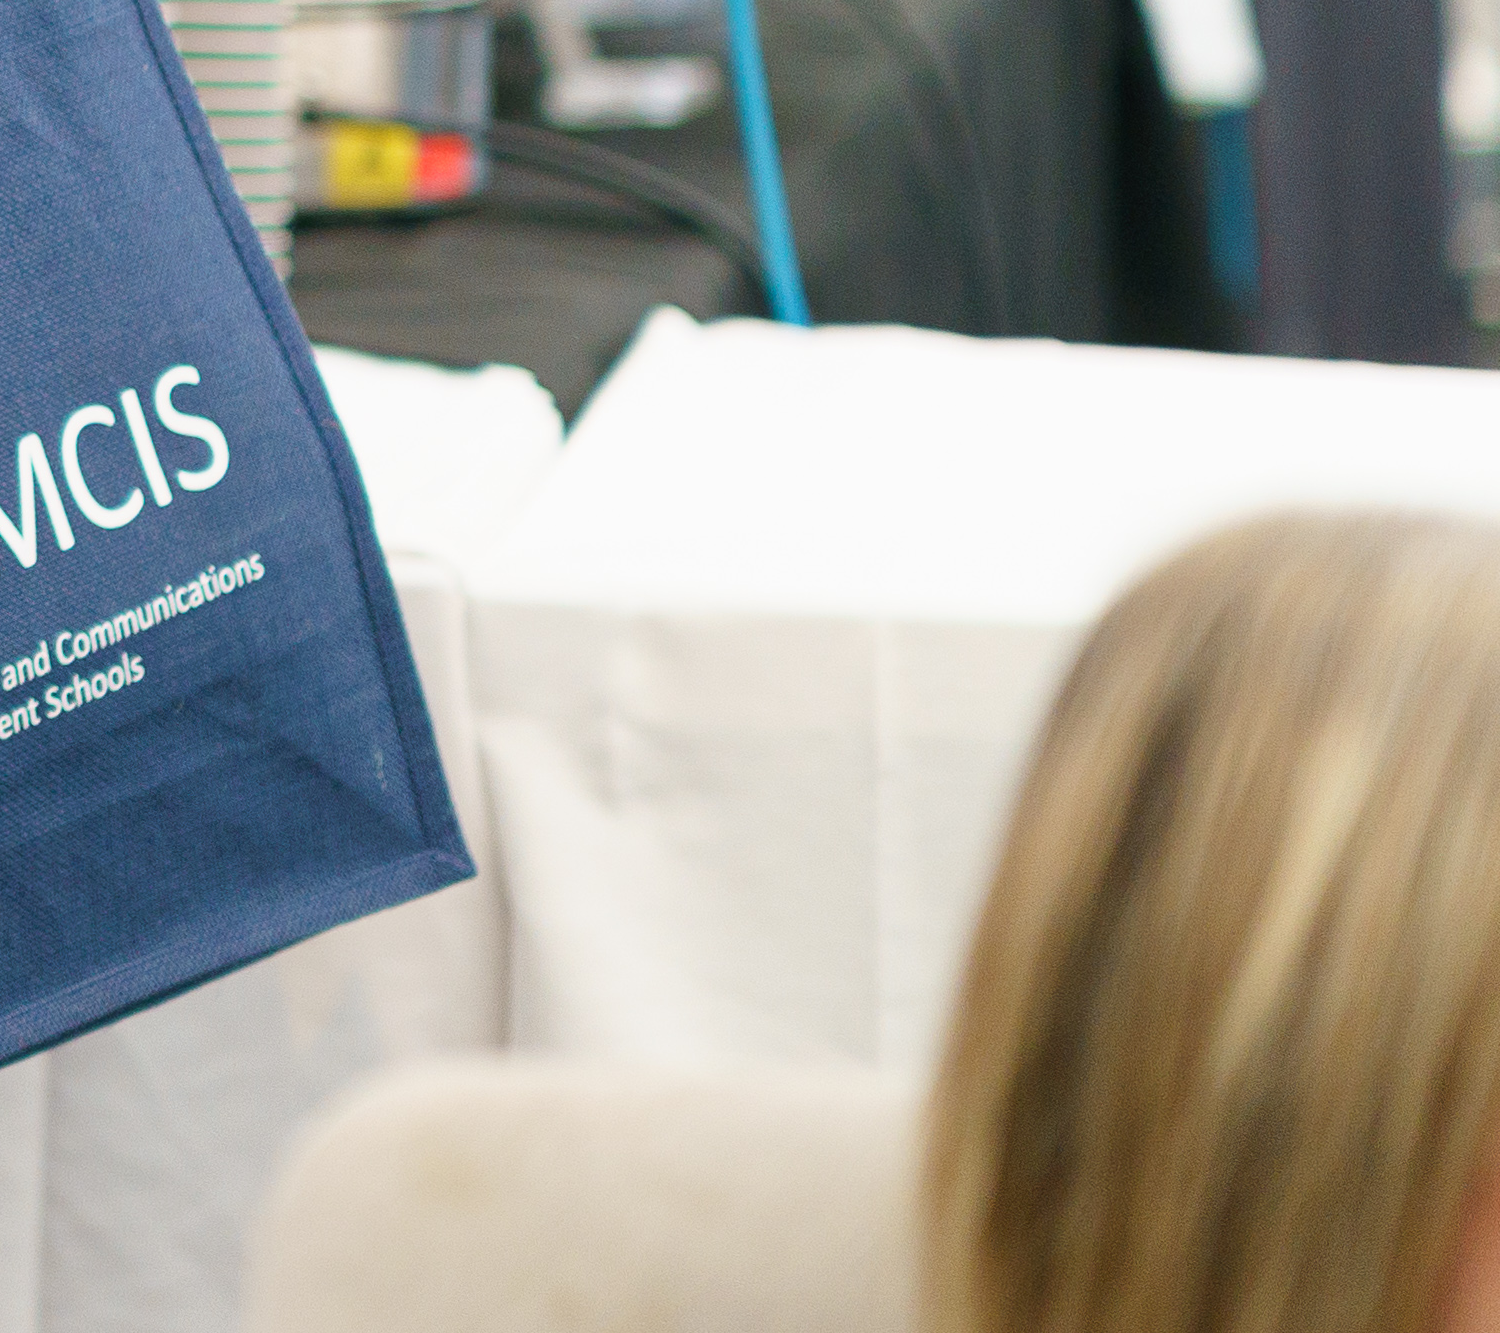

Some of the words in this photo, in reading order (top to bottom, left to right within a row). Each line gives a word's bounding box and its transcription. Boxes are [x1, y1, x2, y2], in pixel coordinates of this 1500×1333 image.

[1, 639, 52, 692] and
[55, 552, 266, 666] Communications
[44, 651, 146, 720] Schools
